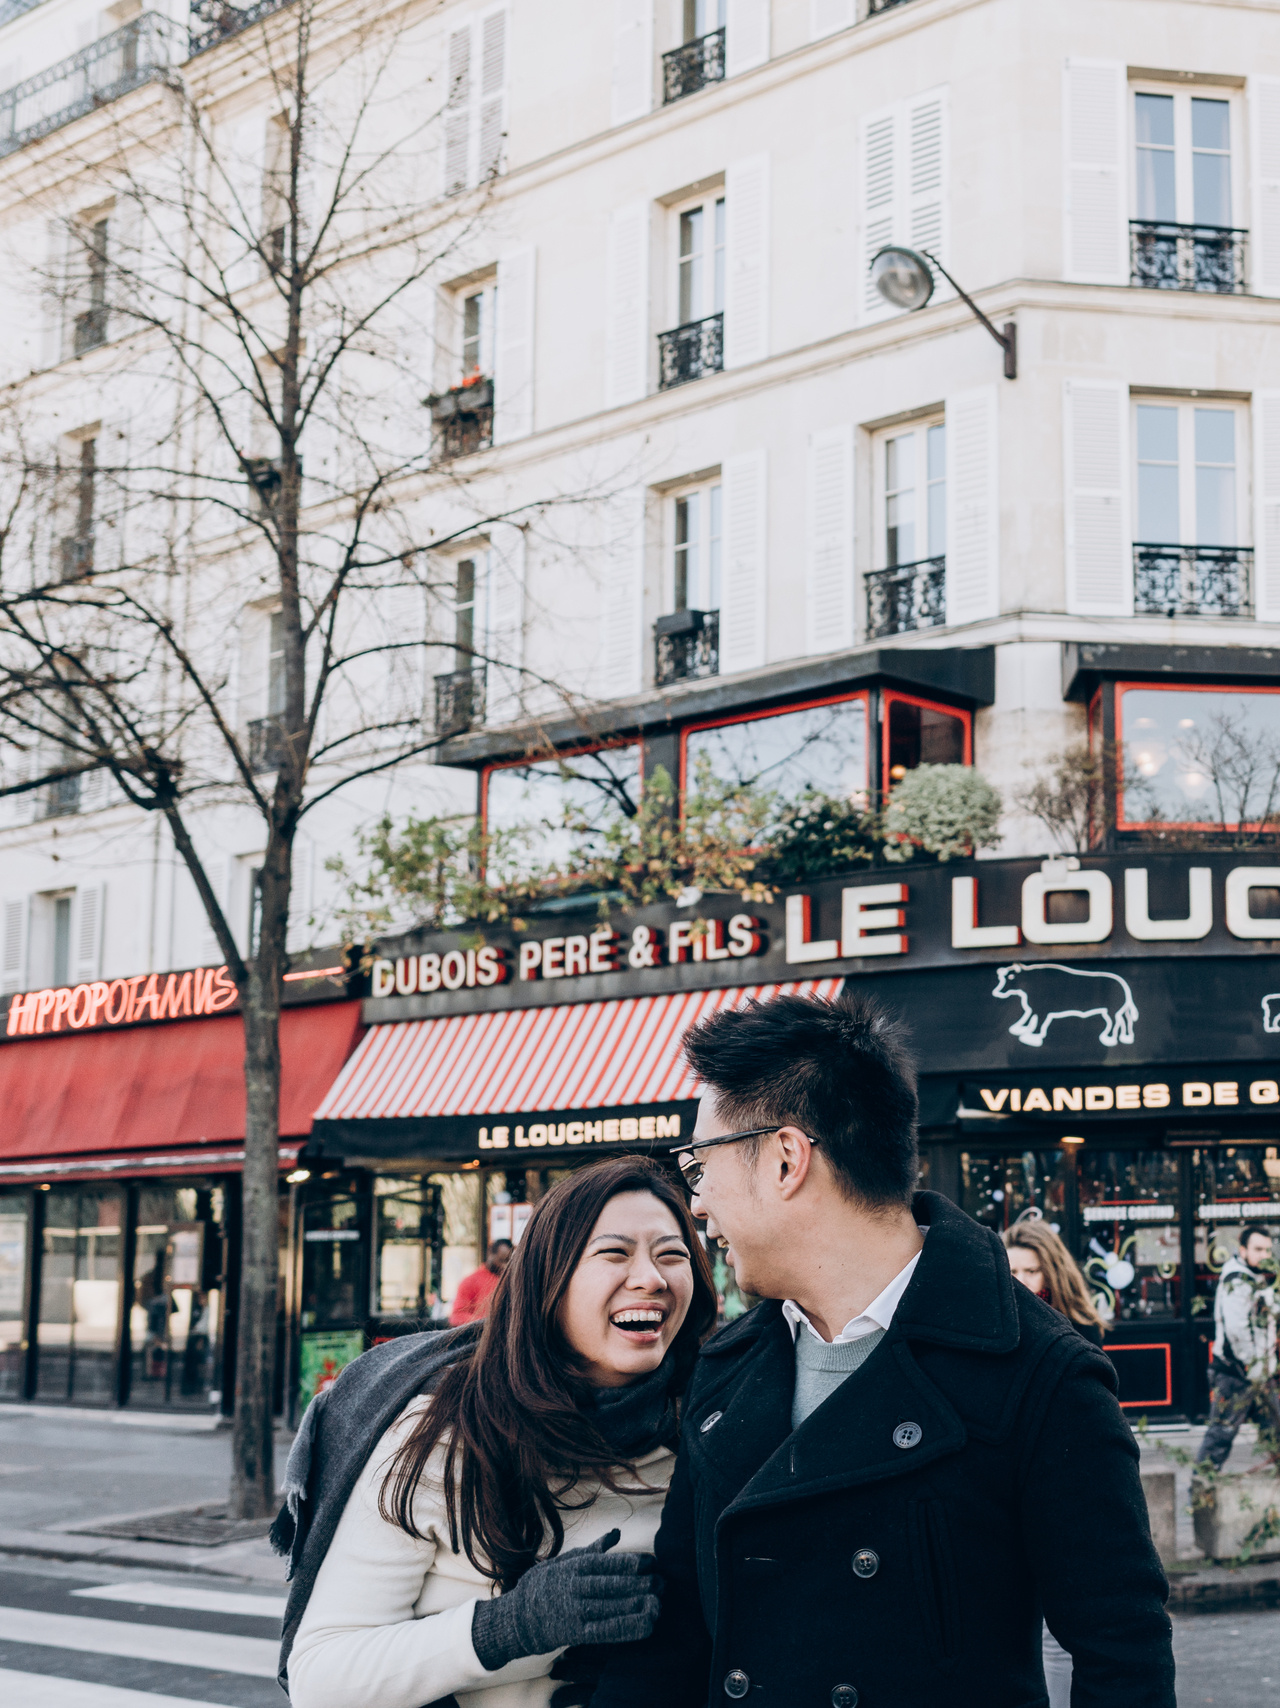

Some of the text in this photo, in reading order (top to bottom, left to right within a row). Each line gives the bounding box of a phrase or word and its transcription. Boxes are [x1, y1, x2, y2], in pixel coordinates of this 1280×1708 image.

[371, 944, 505, 998] DUBOIS
[628, 924, 661, 969] &
[668, 913, 761, 964] FILS
[785, 882, 908, 964] LE
[6, 965, 239, 1036] HIPPOPOTAMUS
[478, 1113, 681, 1149] LE LOUCHEBEM
[979, 1083, 1170, 1112] VIANDES
[1182, 1081, 1239, 1107] DE
